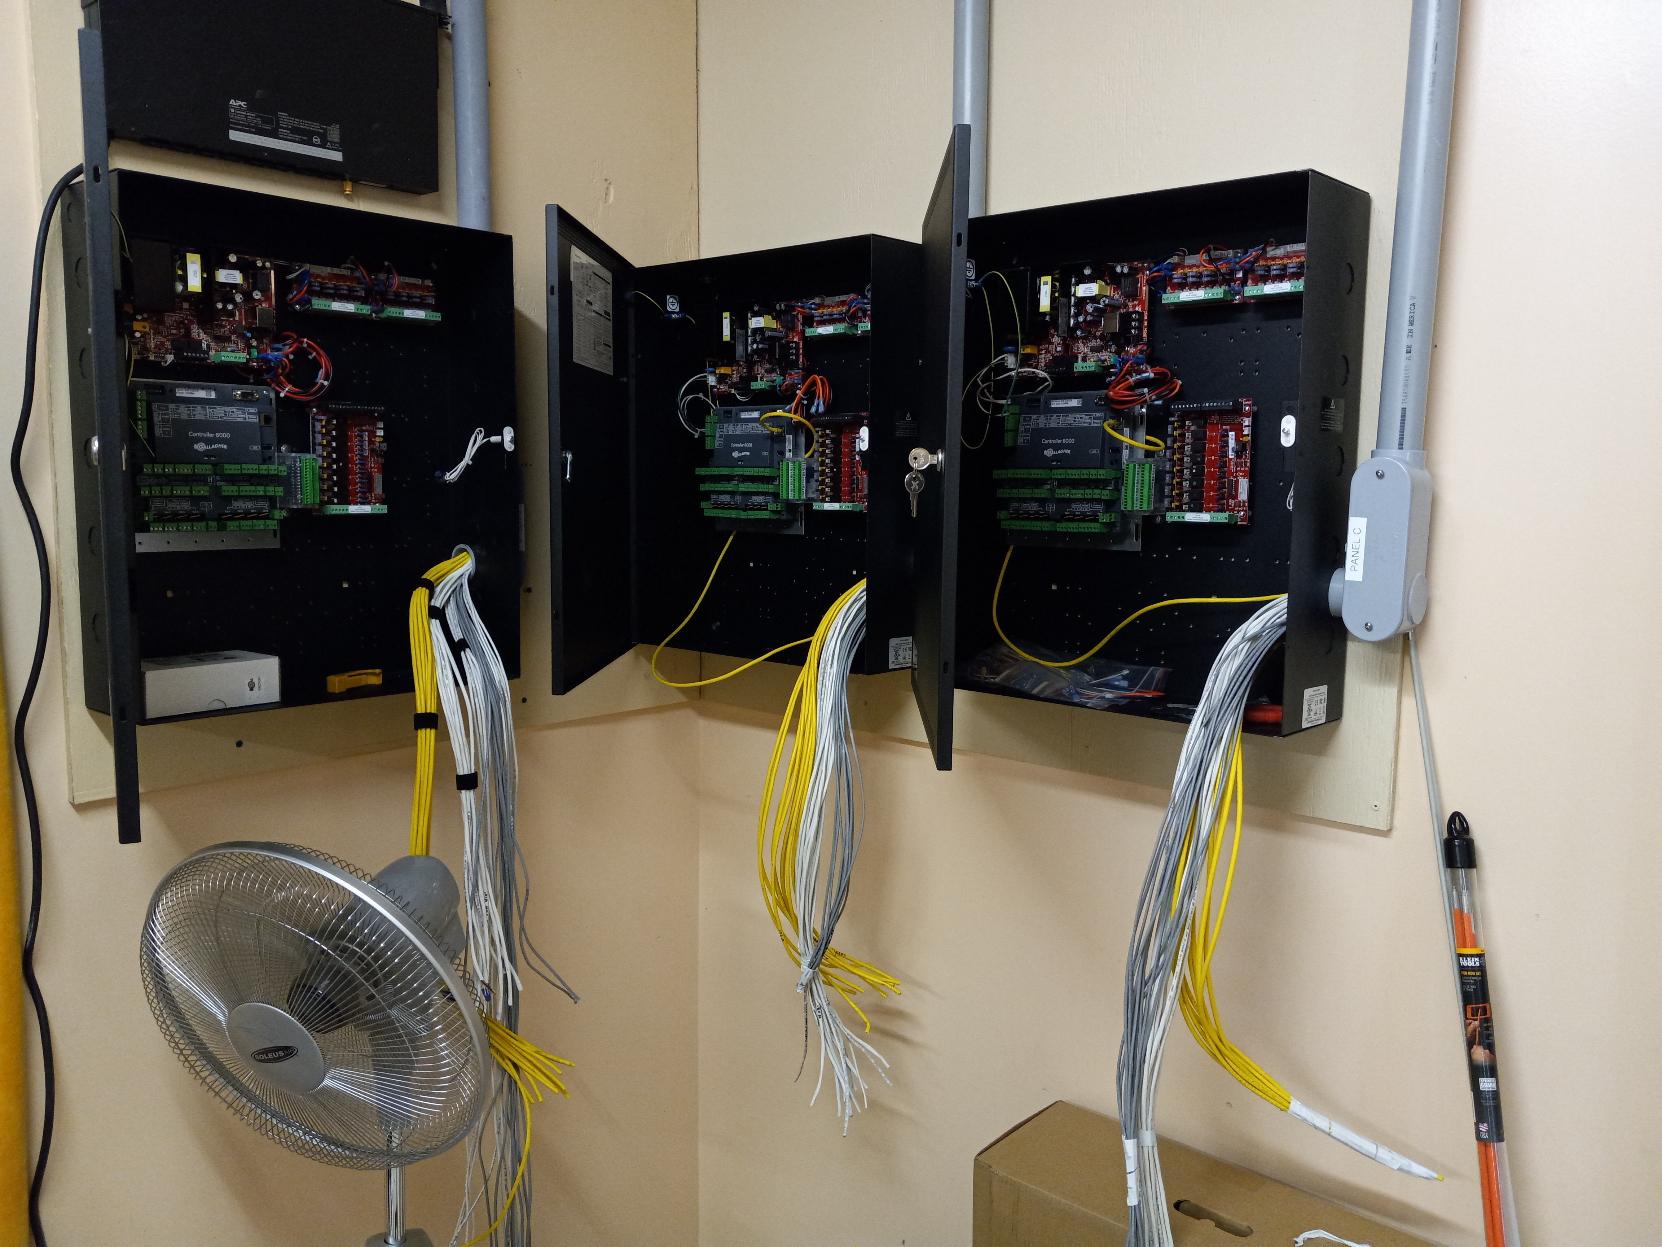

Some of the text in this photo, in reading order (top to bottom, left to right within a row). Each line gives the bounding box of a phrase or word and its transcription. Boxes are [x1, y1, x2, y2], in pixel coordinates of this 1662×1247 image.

[229, 99, 247, 107] APC
[1350, 527, 1362, 572] PANEL C
